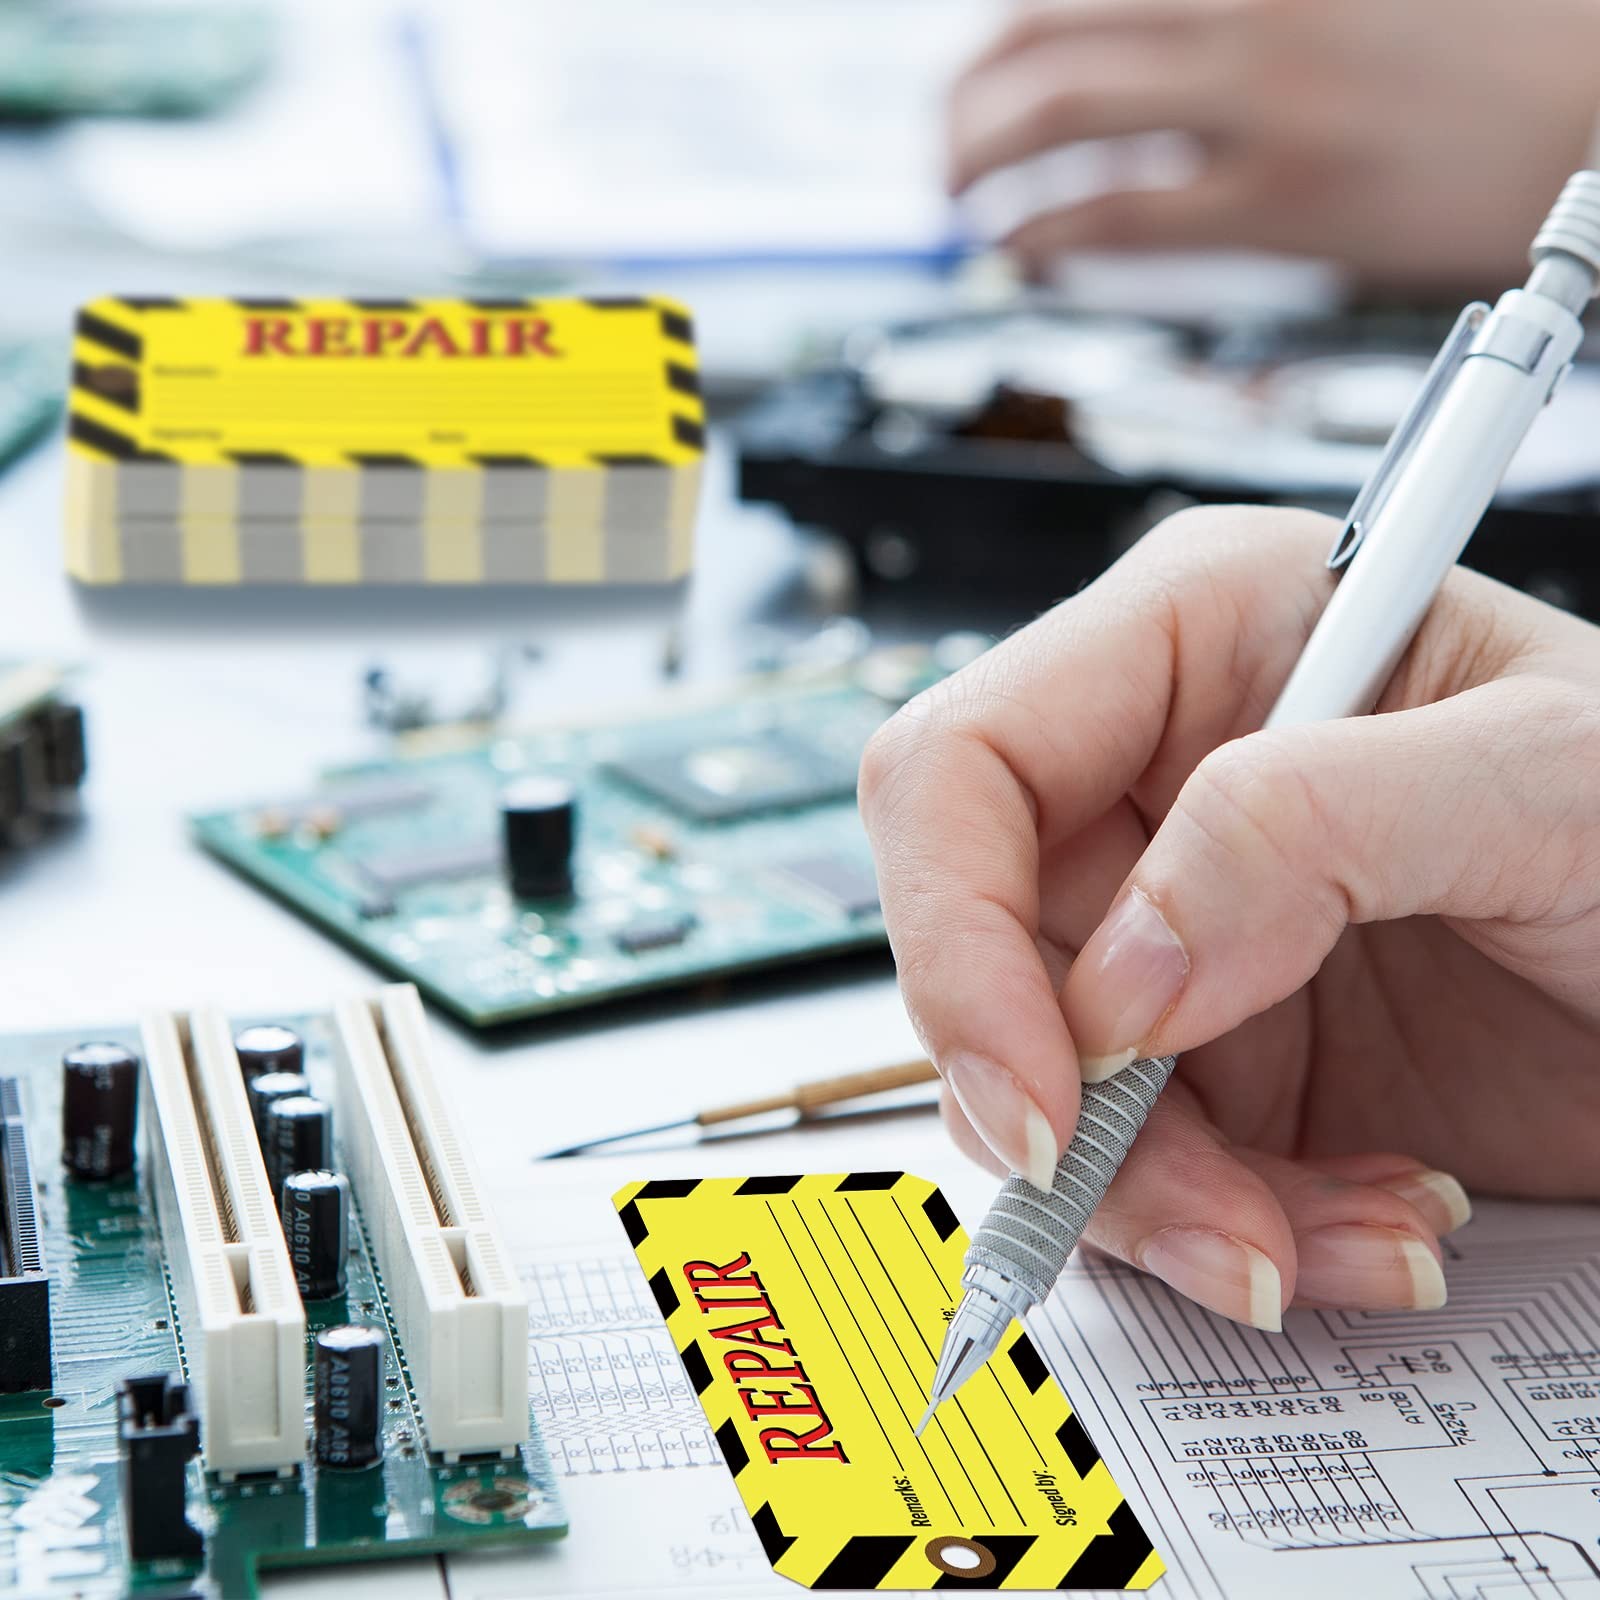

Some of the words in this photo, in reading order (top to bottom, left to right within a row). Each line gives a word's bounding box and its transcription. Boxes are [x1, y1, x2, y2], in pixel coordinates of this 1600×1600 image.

[244, 316, 563, 358] REPAIR
[295, 1208, 311, 1264] A0610
[940, 1307, 956, 1324] te:
[683, 1251, 851, 1464] REPAIR
[330, 1356, 350, 1418] A0610
[1183, 1403, 1207, 1420] A2
[1205, 1402, 1230, 1419] A3
[1229, 1402, 1253, 1418] A4
[1251, 1400, 1276, 1417] A5
[1274, 1399, 1298, 1415] A6
[1298, 1398, 1322, 1414] A7
[1319, 1395, 1344, 1413] A8
[1161, 1406, 1184, 1421] A1
[1433, 1402, 1476, 1446] 74245
[1552, 1420, 1577, 1435] A1
[1203, 1438, 1228, 1456] B2
[1226, 1437, 1251, 1455] B3
[1250, 1435, 1274, 1454] B4
[1272, 1434, 1298, 1453] B5
[1297, 1433, 1321, 1452] B6
[1318, 1432, 1344, 1450] B7
[1342, 1430, 1368, 1449] B8
[1181, 1441, 1204, 1457] B1
[1032, 1470, 1057, 1488] by:
[892, 1476, 932, 1527] Remarks:
[1037, 1489, 1077, 1526] Signed
